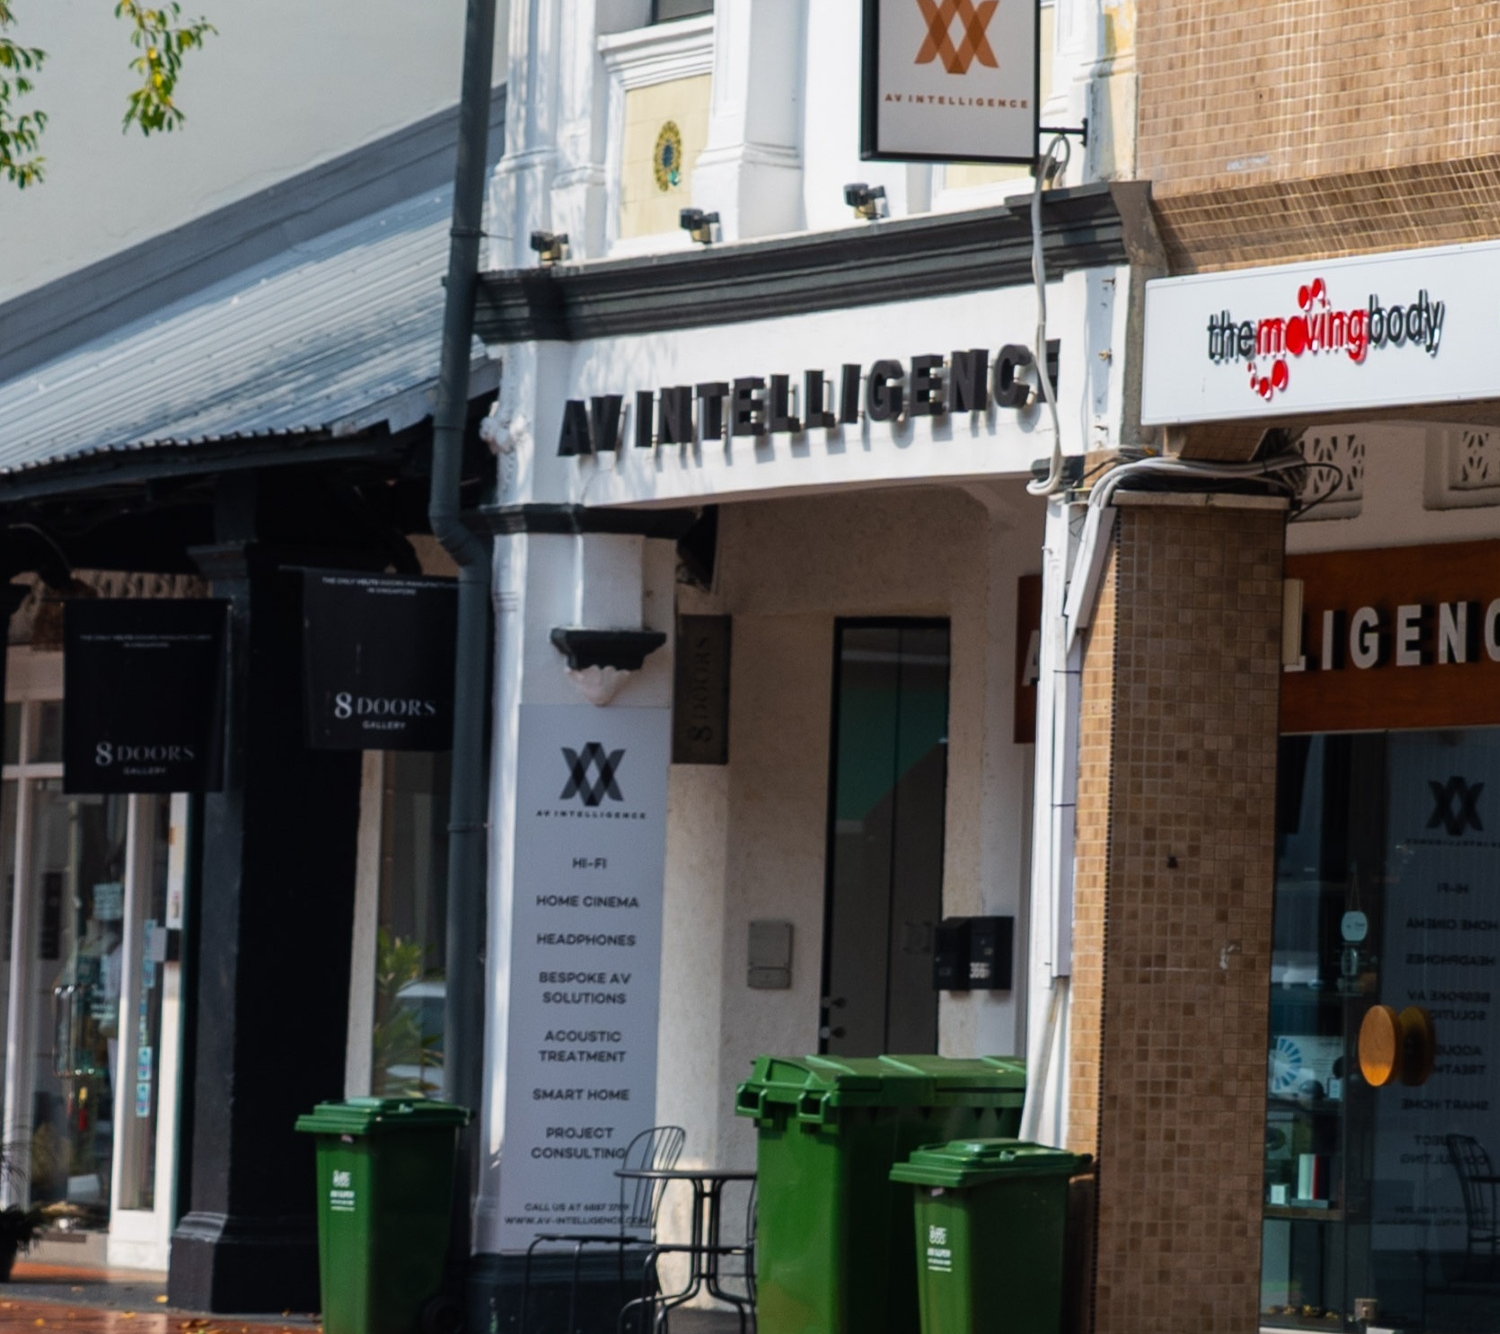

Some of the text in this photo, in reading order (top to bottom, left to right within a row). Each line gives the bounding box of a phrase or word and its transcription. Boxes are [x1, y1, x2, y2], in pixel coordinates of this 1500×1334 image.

[884, 94, 1028, 109] AV INTELLIGENCE
[557, 394, 622, 456] AV
[334, 691, 436, 720] 8 DOORS
[362, 720, 406, 730] GALLERY
[94, 740, 195, 766] 8 DOORS
[572, 857, 608, 869] HI-FI
[536, 895, 639, 908] HOME CINEMA
[537, 933, 636, 946] HEADPHONES
[539, 971, 632, 984] BESPOKE AV
[542, 992, 626, 1004] SOLUTIONS
[544, 1030, 622, 1042] ACOUSTIC
[538, 1050, 626, 1062] TREATMENT
[533, 1088, 630, 1101] SMART HOME
[546, 1127, 614, 1139] PROJECT
[531, 1147, 627, 1159] CONSULTING
[524, 1203, 550, 1211] CALL
